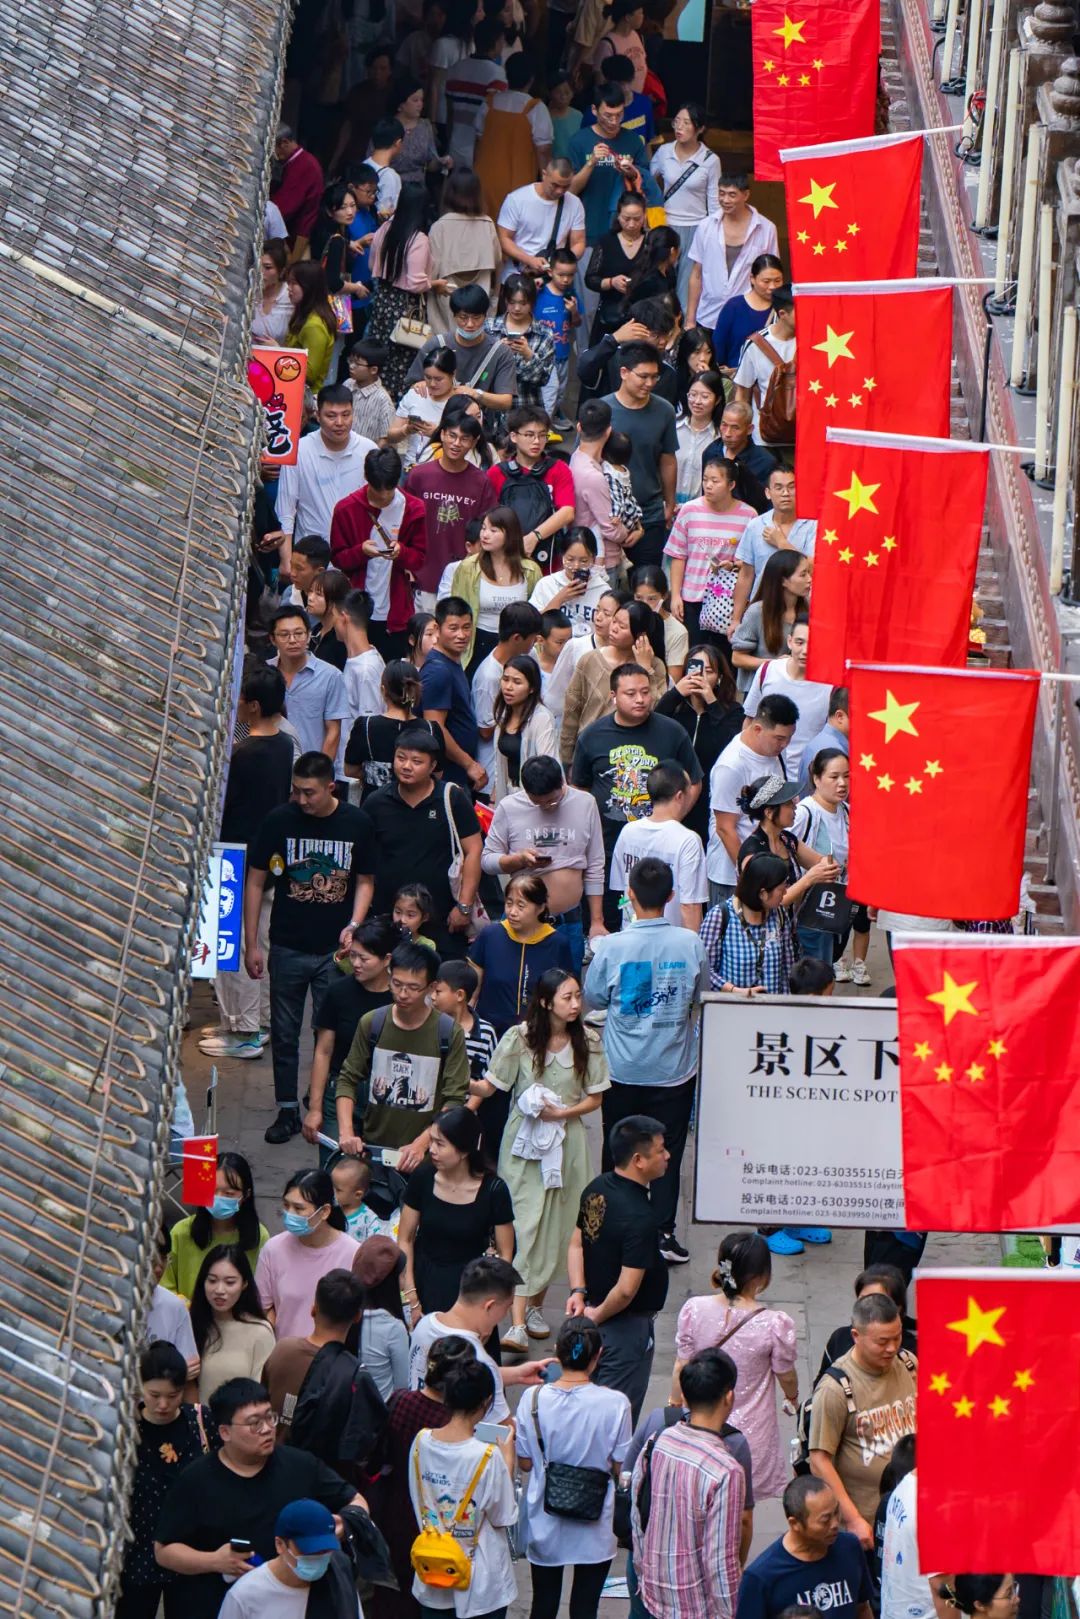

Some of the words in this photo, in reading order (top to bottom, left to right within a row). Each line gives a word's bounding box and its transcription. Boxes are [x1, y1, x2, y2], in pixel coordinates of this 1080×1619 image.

[423, 492, 476, 506] GICHNVEY
[525, 827, 576, 841] SYSTEM
[658, 961, 687, 970] LEARN
[746, 1084, 782, 1099] THE
[785, 1086, 850, 1102] SCENIC
[853, 1088, 899, 1104] SPOT
[741, 1177, 784, 1187] Complaint
[740, 1207, 782, 1217] Complaint
[871, 1212, 899, 1221] (night)
